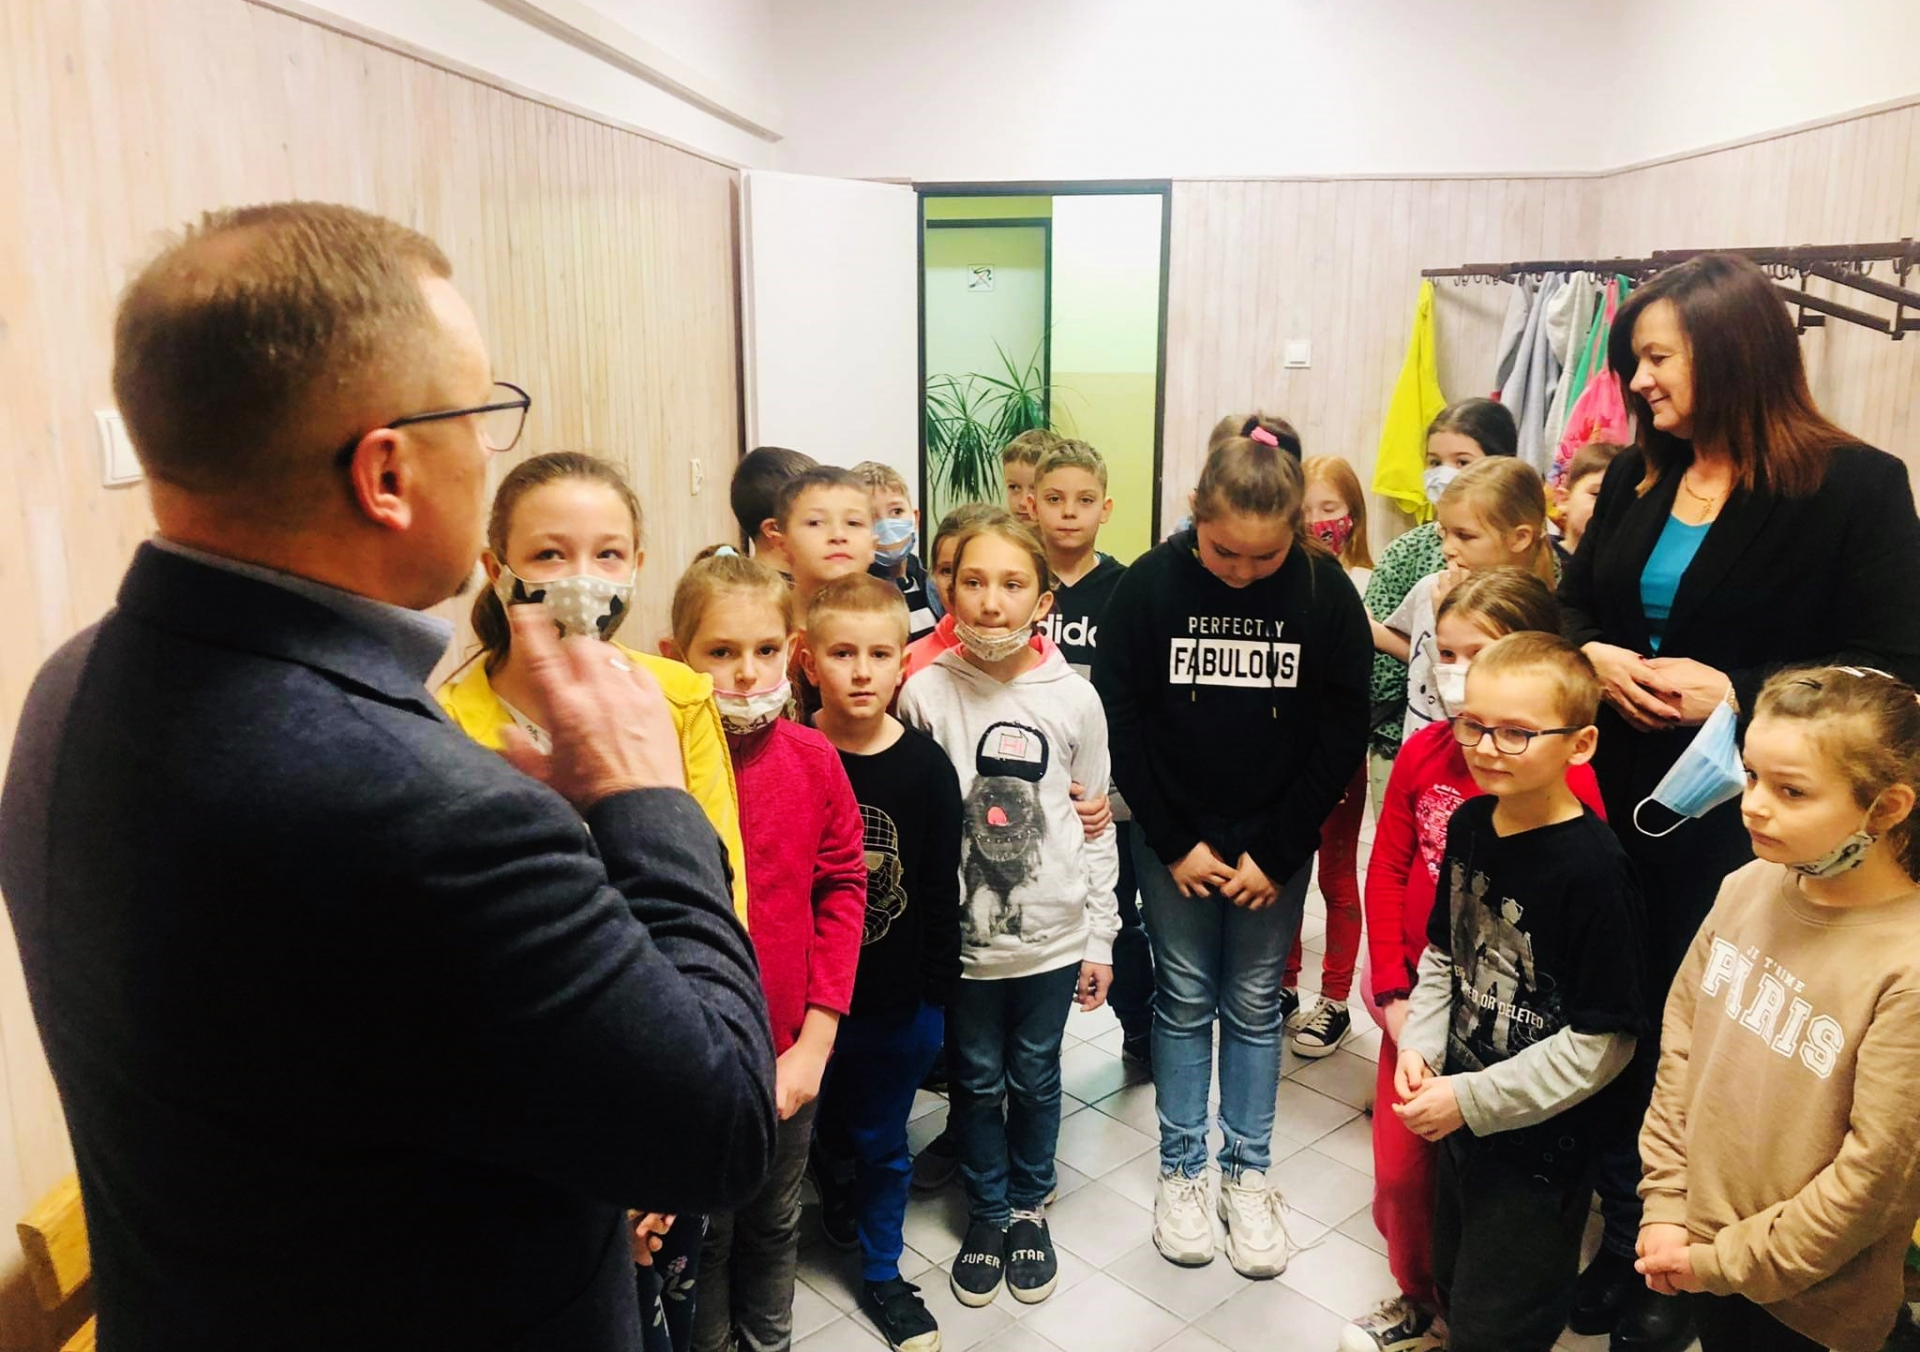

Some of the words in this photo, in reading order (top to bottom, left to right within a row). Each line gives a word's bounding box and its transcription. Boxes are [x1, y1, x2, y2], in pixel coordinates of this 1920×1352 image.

[1174, 647, 1296, 679] FABULOUS
[1480, 993, 1497, 1011] OR
[1498, 1001, 1544, 1030] DELETED
[961, 1253, 1001, 1269] SUPER
[1011, 1248, 1045, 1262] STAR
